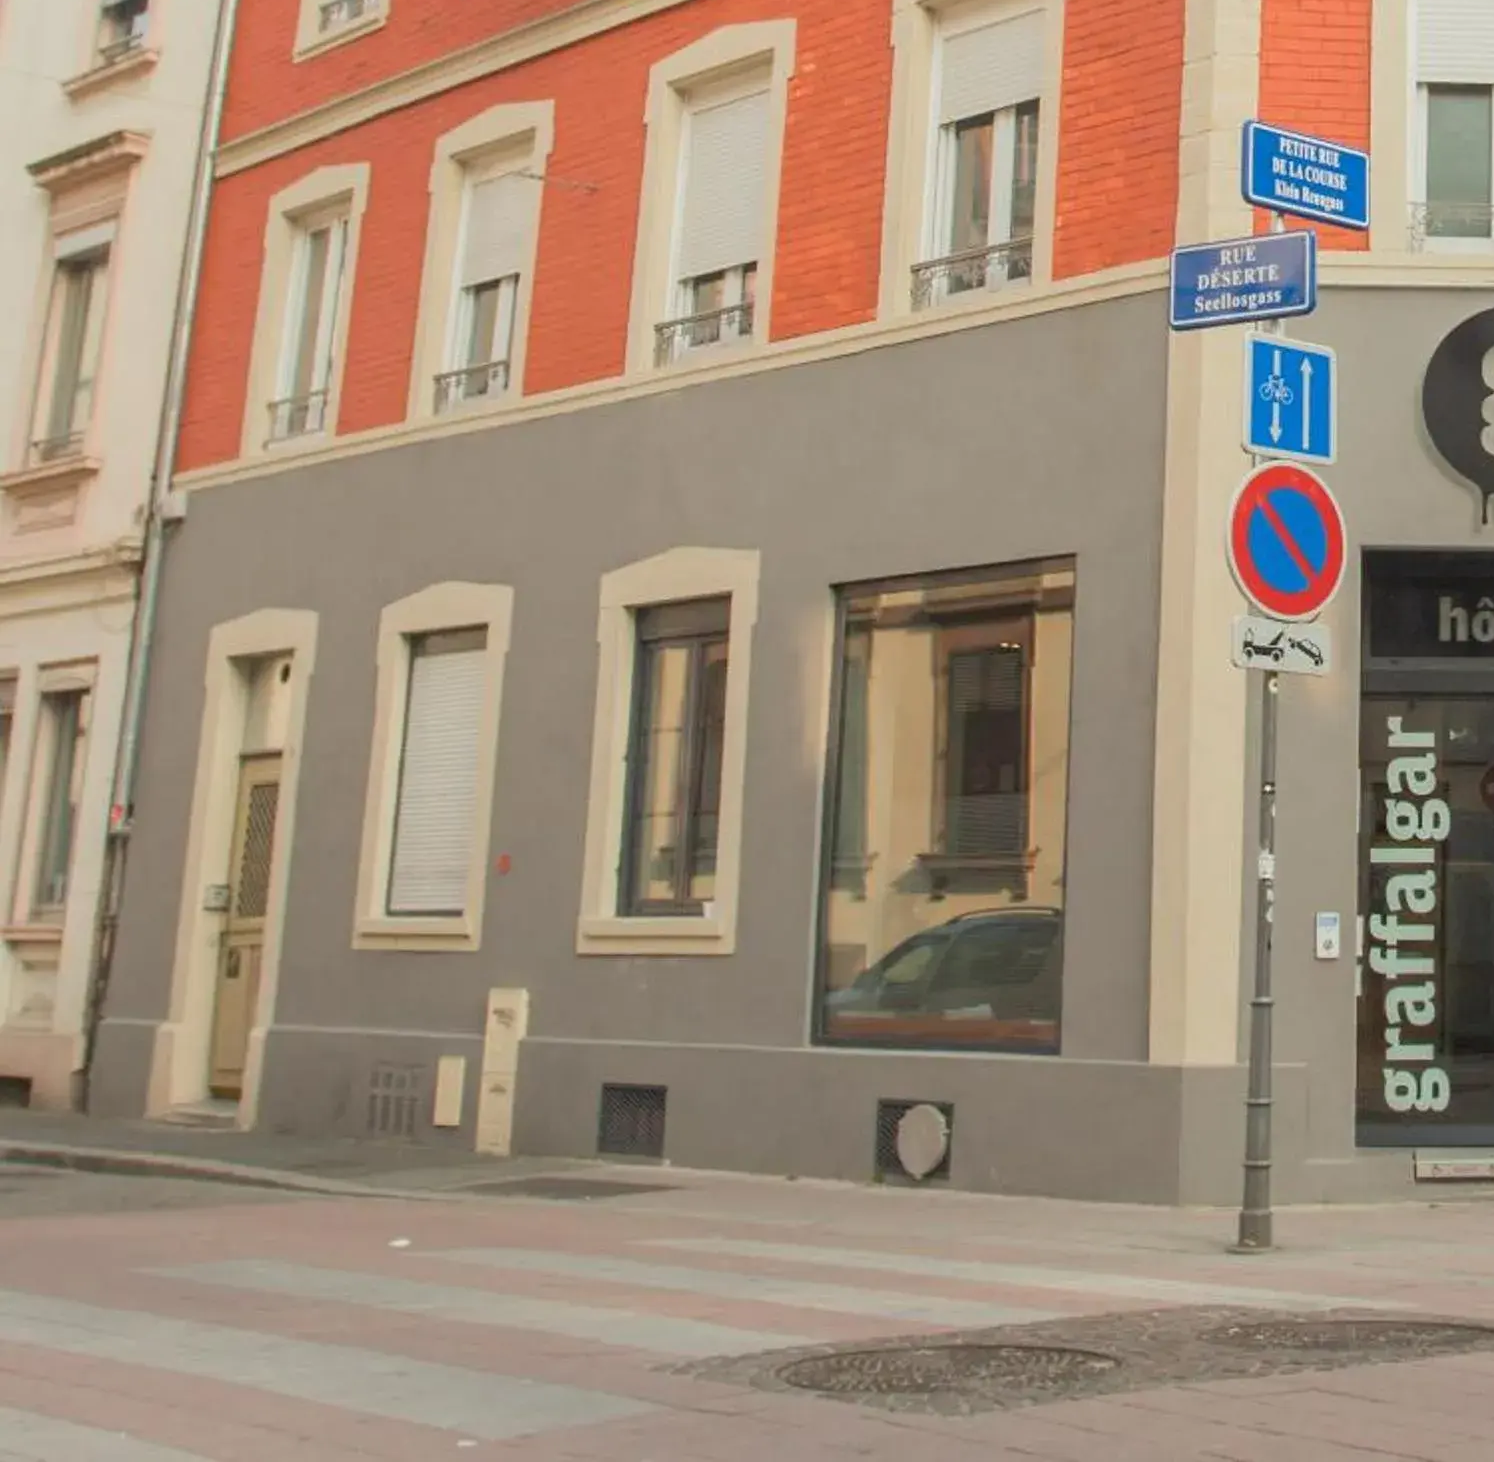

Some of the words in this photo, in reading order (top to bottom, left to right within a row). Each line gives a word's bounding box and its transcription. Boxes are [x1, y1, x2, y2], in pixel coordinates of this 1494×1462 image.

[1279, 136, 1318, 163] PETITE
[1318, 147, 1341, 168] RUE
[1272, 156, 1288, 176] DE
[1289, 160, 1304, 180] LA
[1305, 165, 1348, 192] COURSE
[1219, 244, 1257, 266] RUE
[1197, 264, 1280, 291] DÉSERTE
[1369, 715, 1451, 1112] graffalgar
